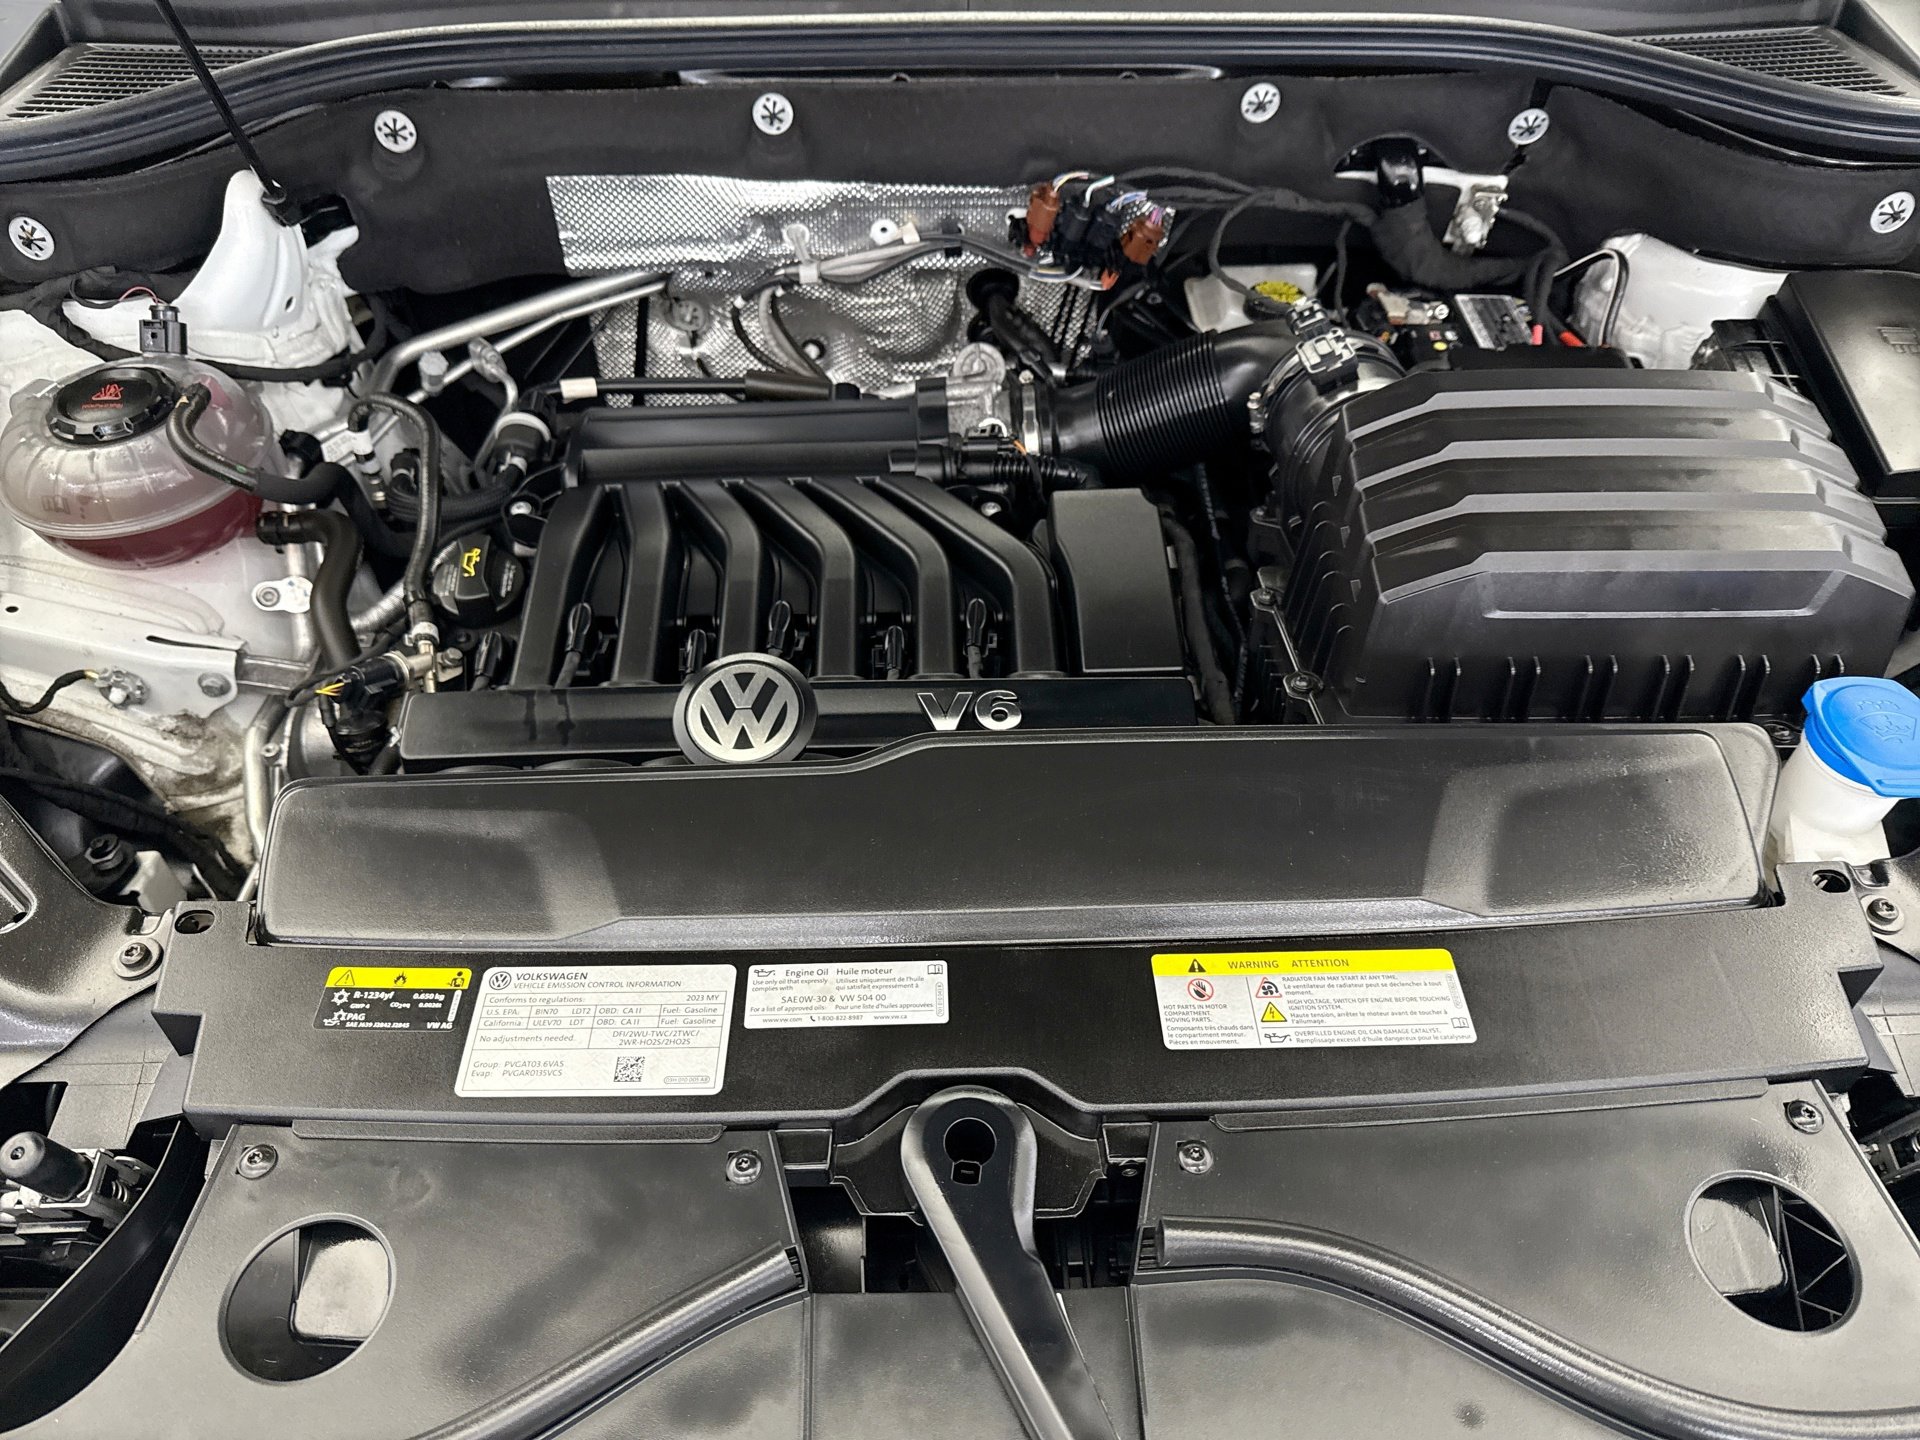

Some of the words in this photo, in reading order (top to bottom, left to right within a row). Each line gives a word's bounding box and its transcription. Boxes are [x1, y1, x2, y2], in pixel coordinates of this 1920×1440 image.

[687, 663, 799, 761] VW
[917, 690, 1022, 731] V6
[1228, 960, 1279, 969] WARNING
[1292, 959, 1350, 968] ATTENTION
[786, 970, 814, 978] Engine
[353, 991, 394, 1000] R-1234yf
[493, 1035, 542, 1043] adjustments
